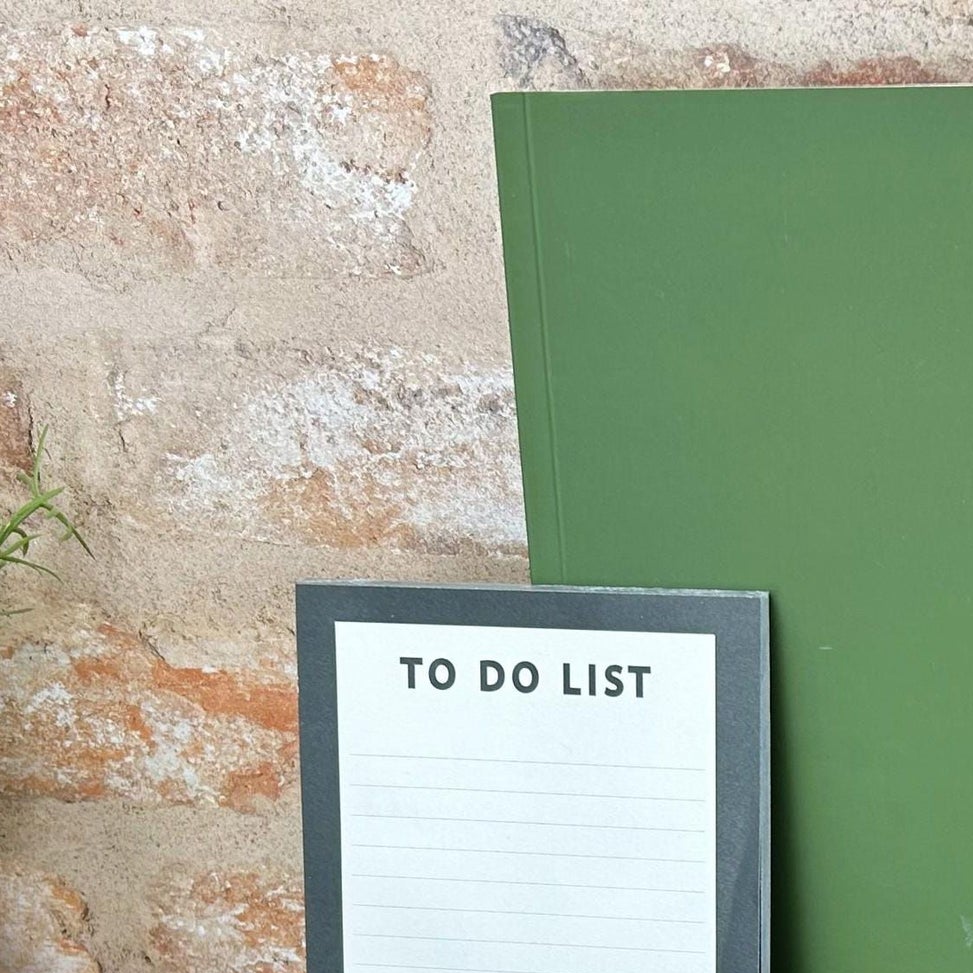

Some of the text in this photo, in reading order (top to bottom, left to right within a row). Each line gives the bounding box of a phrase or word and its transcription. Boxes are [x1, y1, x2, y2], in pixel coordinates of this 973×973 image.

[400, 657, 651, 698] TO DO LIST
